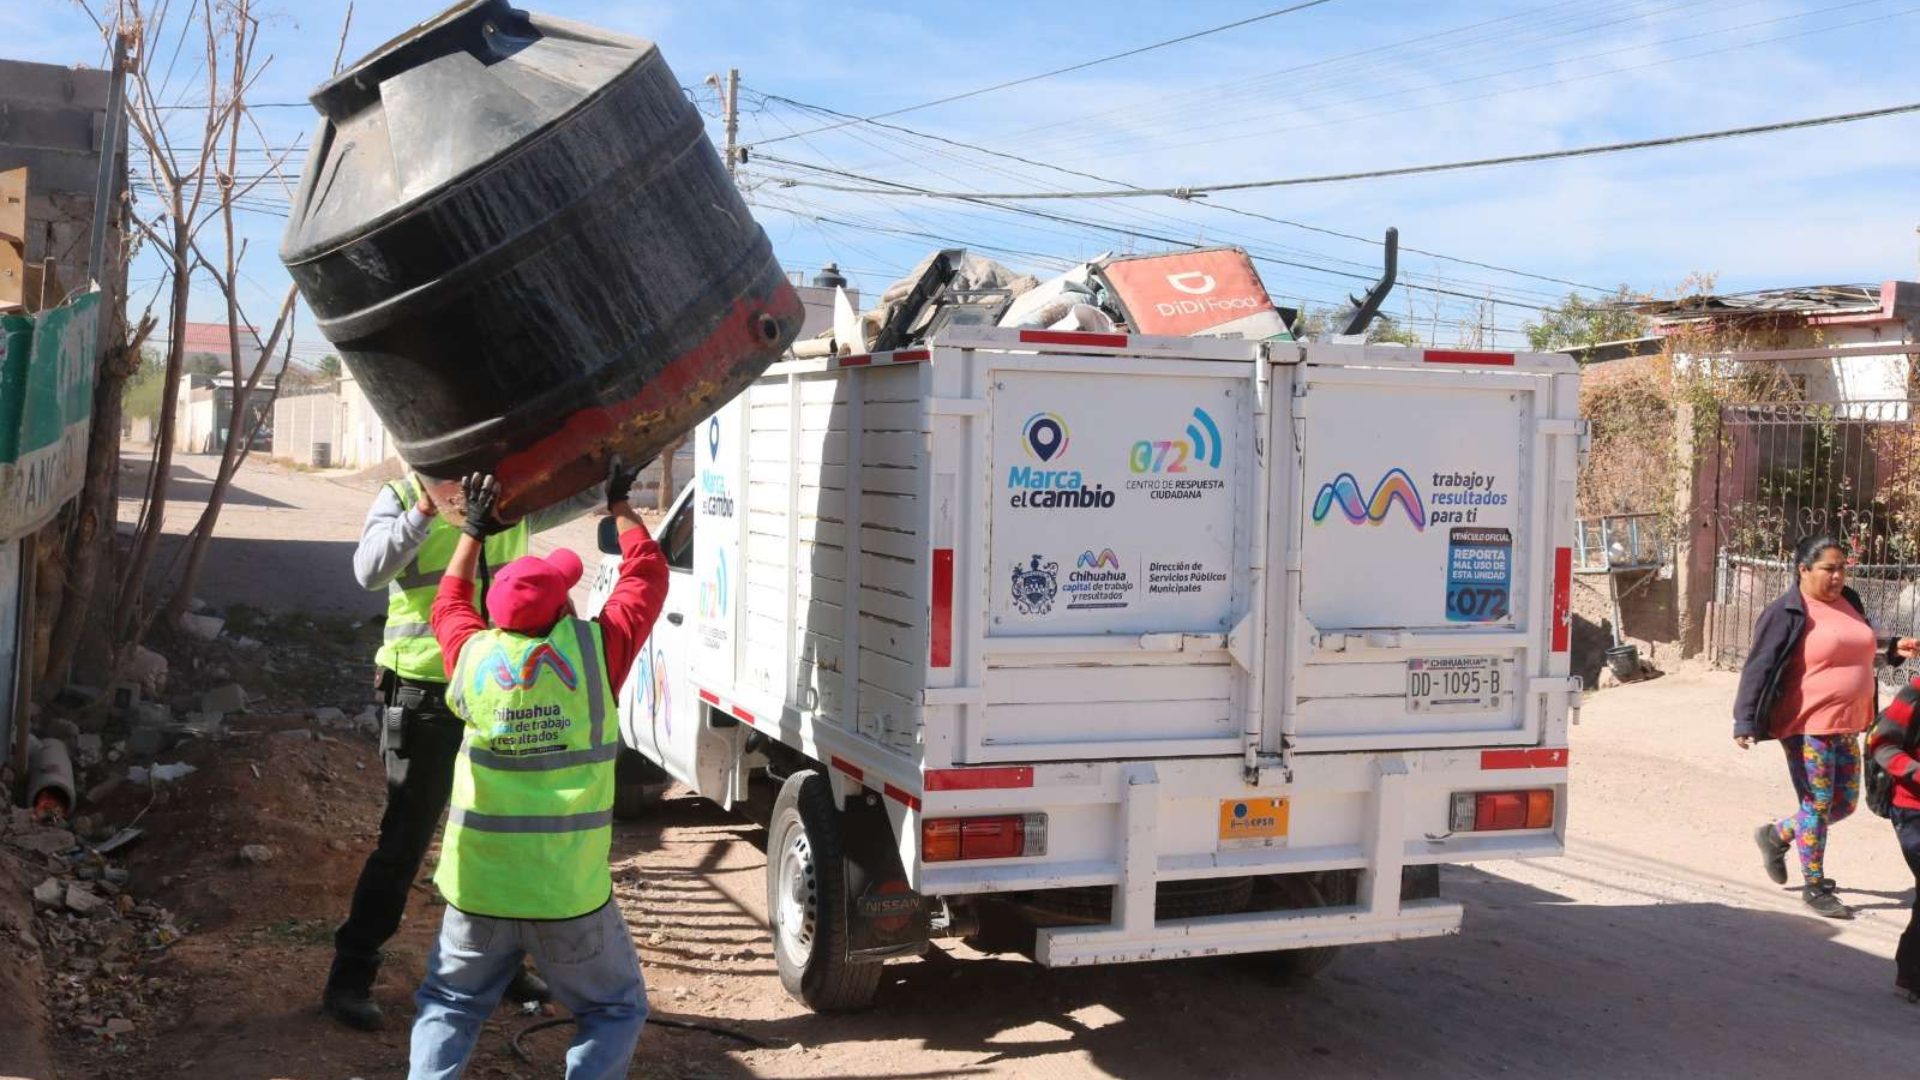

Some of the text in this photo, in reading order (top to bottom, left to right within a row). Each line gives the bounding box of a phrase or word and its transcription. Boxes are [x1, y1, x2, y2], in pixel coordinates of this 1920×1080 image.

[1207, 295, 1258, 313] Food
[1128, 440, 1189, 474] 072
[1008, 466, 1082, 489] Marca
[1432, 471, 1495, 491] trabajo y
[1126, 480, 1224, 490] CENTRO DE RESPUESTA
[1010, 484, 1116, 508] el cambio
[1150, 490, 1202, 499] CIUDADANA
[1431, 490, 1508, 505] resultados
[1430, 507, 1478, 526] para ti
[1454, 548, 1506, 560] REPORTA
[1149, 561, 1203, 571] Dirección de
[1453, 561, 1506, 570] MAL USO DE
[1069, 570, 1127, 582] Chihuahua
[1149, 572, 1227, 583] Servicios Públicos
[1452, 570, 1506, 580] ESTA UNIDAD
[1062, 580, 1134, 593] capital de trabajo
[1149, 584, 1202, 595] Municipales
[1078, 591, 1123, 600] resultados
[1431, 658, 1480, 667] CHIHUAHUA
[1411, 670, 1500, 697] DD-1095-B
[516, 721, 530, 733] de
[532, 716, 571, 731] trabajo
